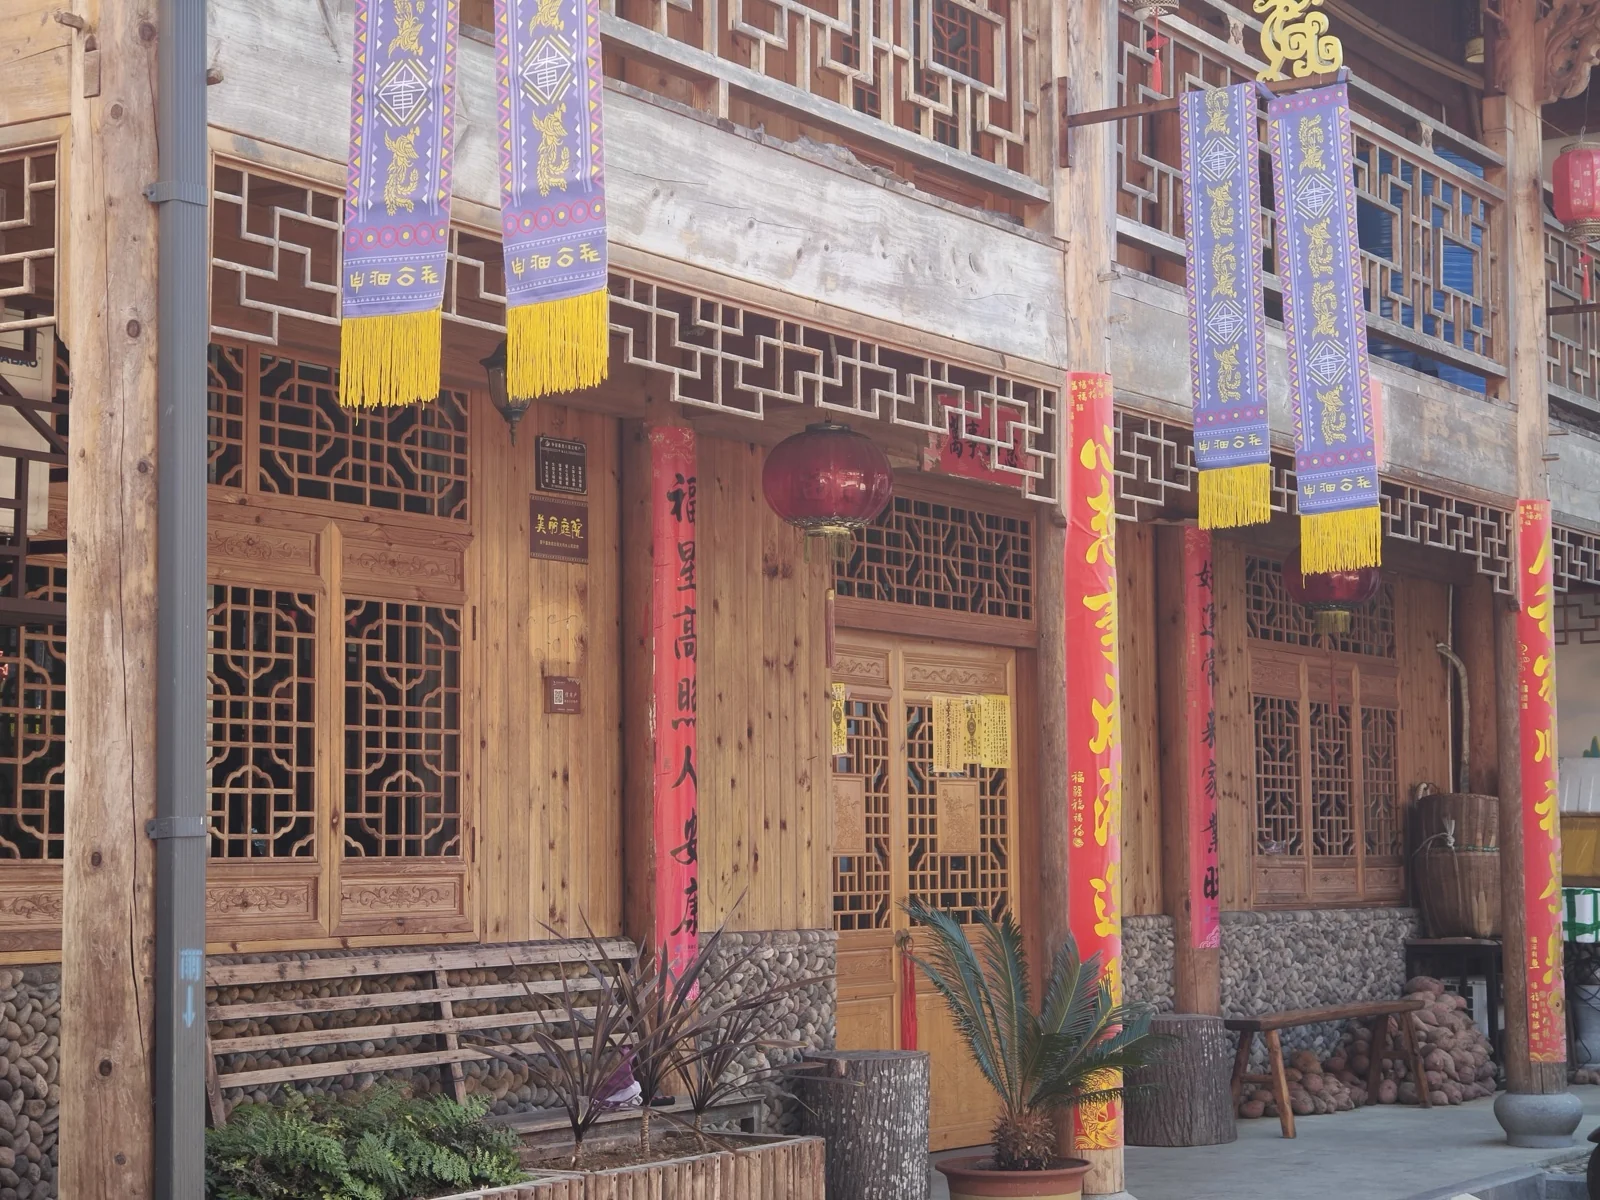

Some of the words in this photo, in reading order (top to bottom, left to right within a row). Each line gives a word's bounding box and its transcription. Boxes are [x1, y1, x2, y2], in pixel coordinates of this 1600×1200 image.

[666, 473, 698, 937] 福星高照人安康
